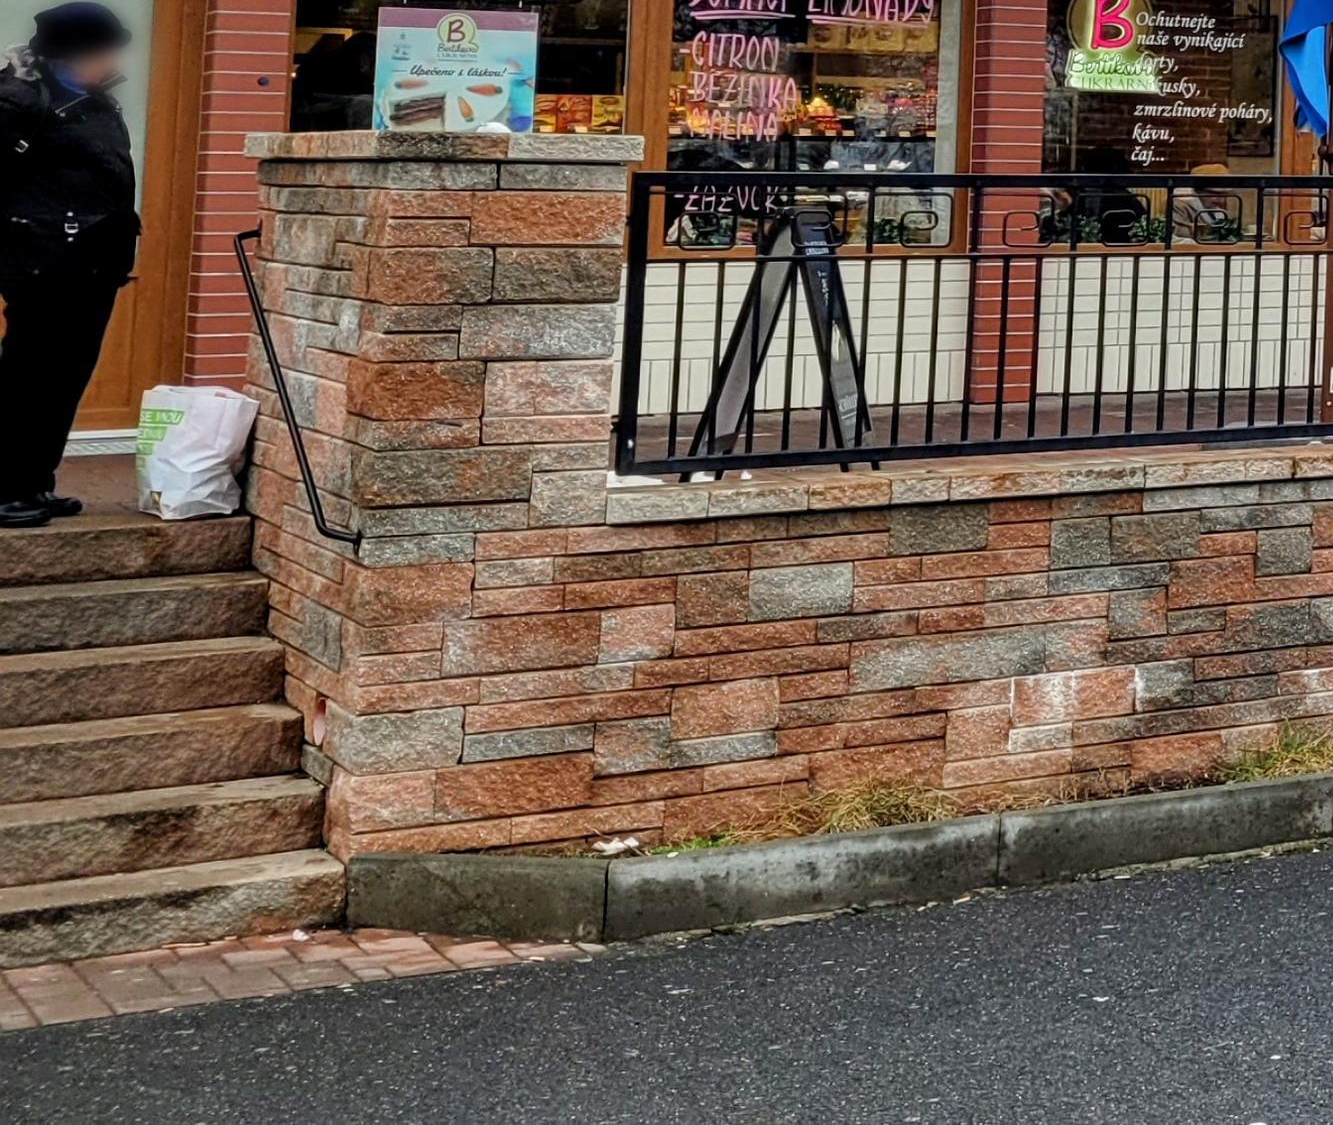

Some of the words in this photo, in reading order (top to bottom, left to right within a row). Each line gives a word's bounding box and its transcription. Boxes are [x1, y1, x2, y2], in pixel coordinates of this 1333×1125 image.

[447, 18, 466, 44] B
[1136, 11, 1216, 33] Ochutnejte
[1137, 31, 1169, 47] naše
[1173, 31, 1247, 53] vynikající
[1133, 100, 1217, 118] zmrzlinové
[1218, 102, 1274, 123] poháry,
[1132, 122, 1176, 143] kávu,
